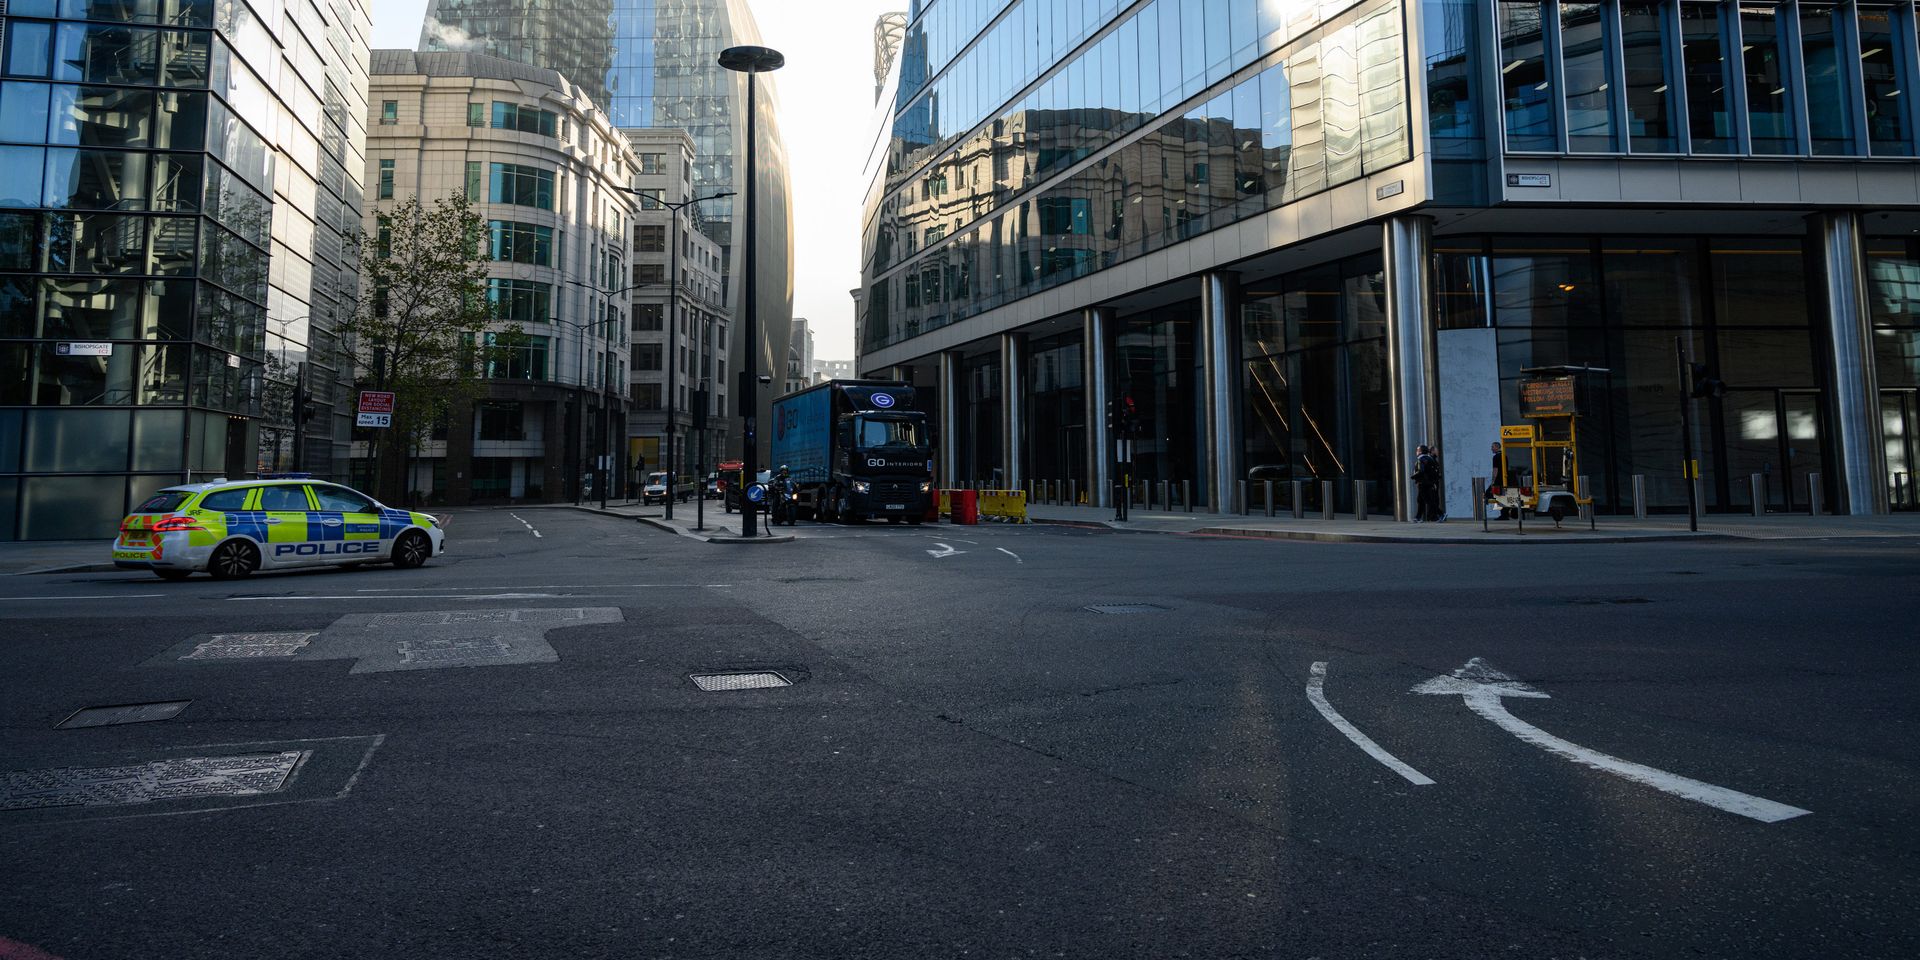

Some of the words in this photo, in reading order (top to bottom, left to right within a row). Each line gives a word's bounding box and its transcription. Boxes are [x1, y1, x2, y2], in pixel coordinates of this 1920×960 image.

[376, 416, 389, 425] 15
[867, 458, 886, 467] GO
[275, 541, 380, 556] POLICE
